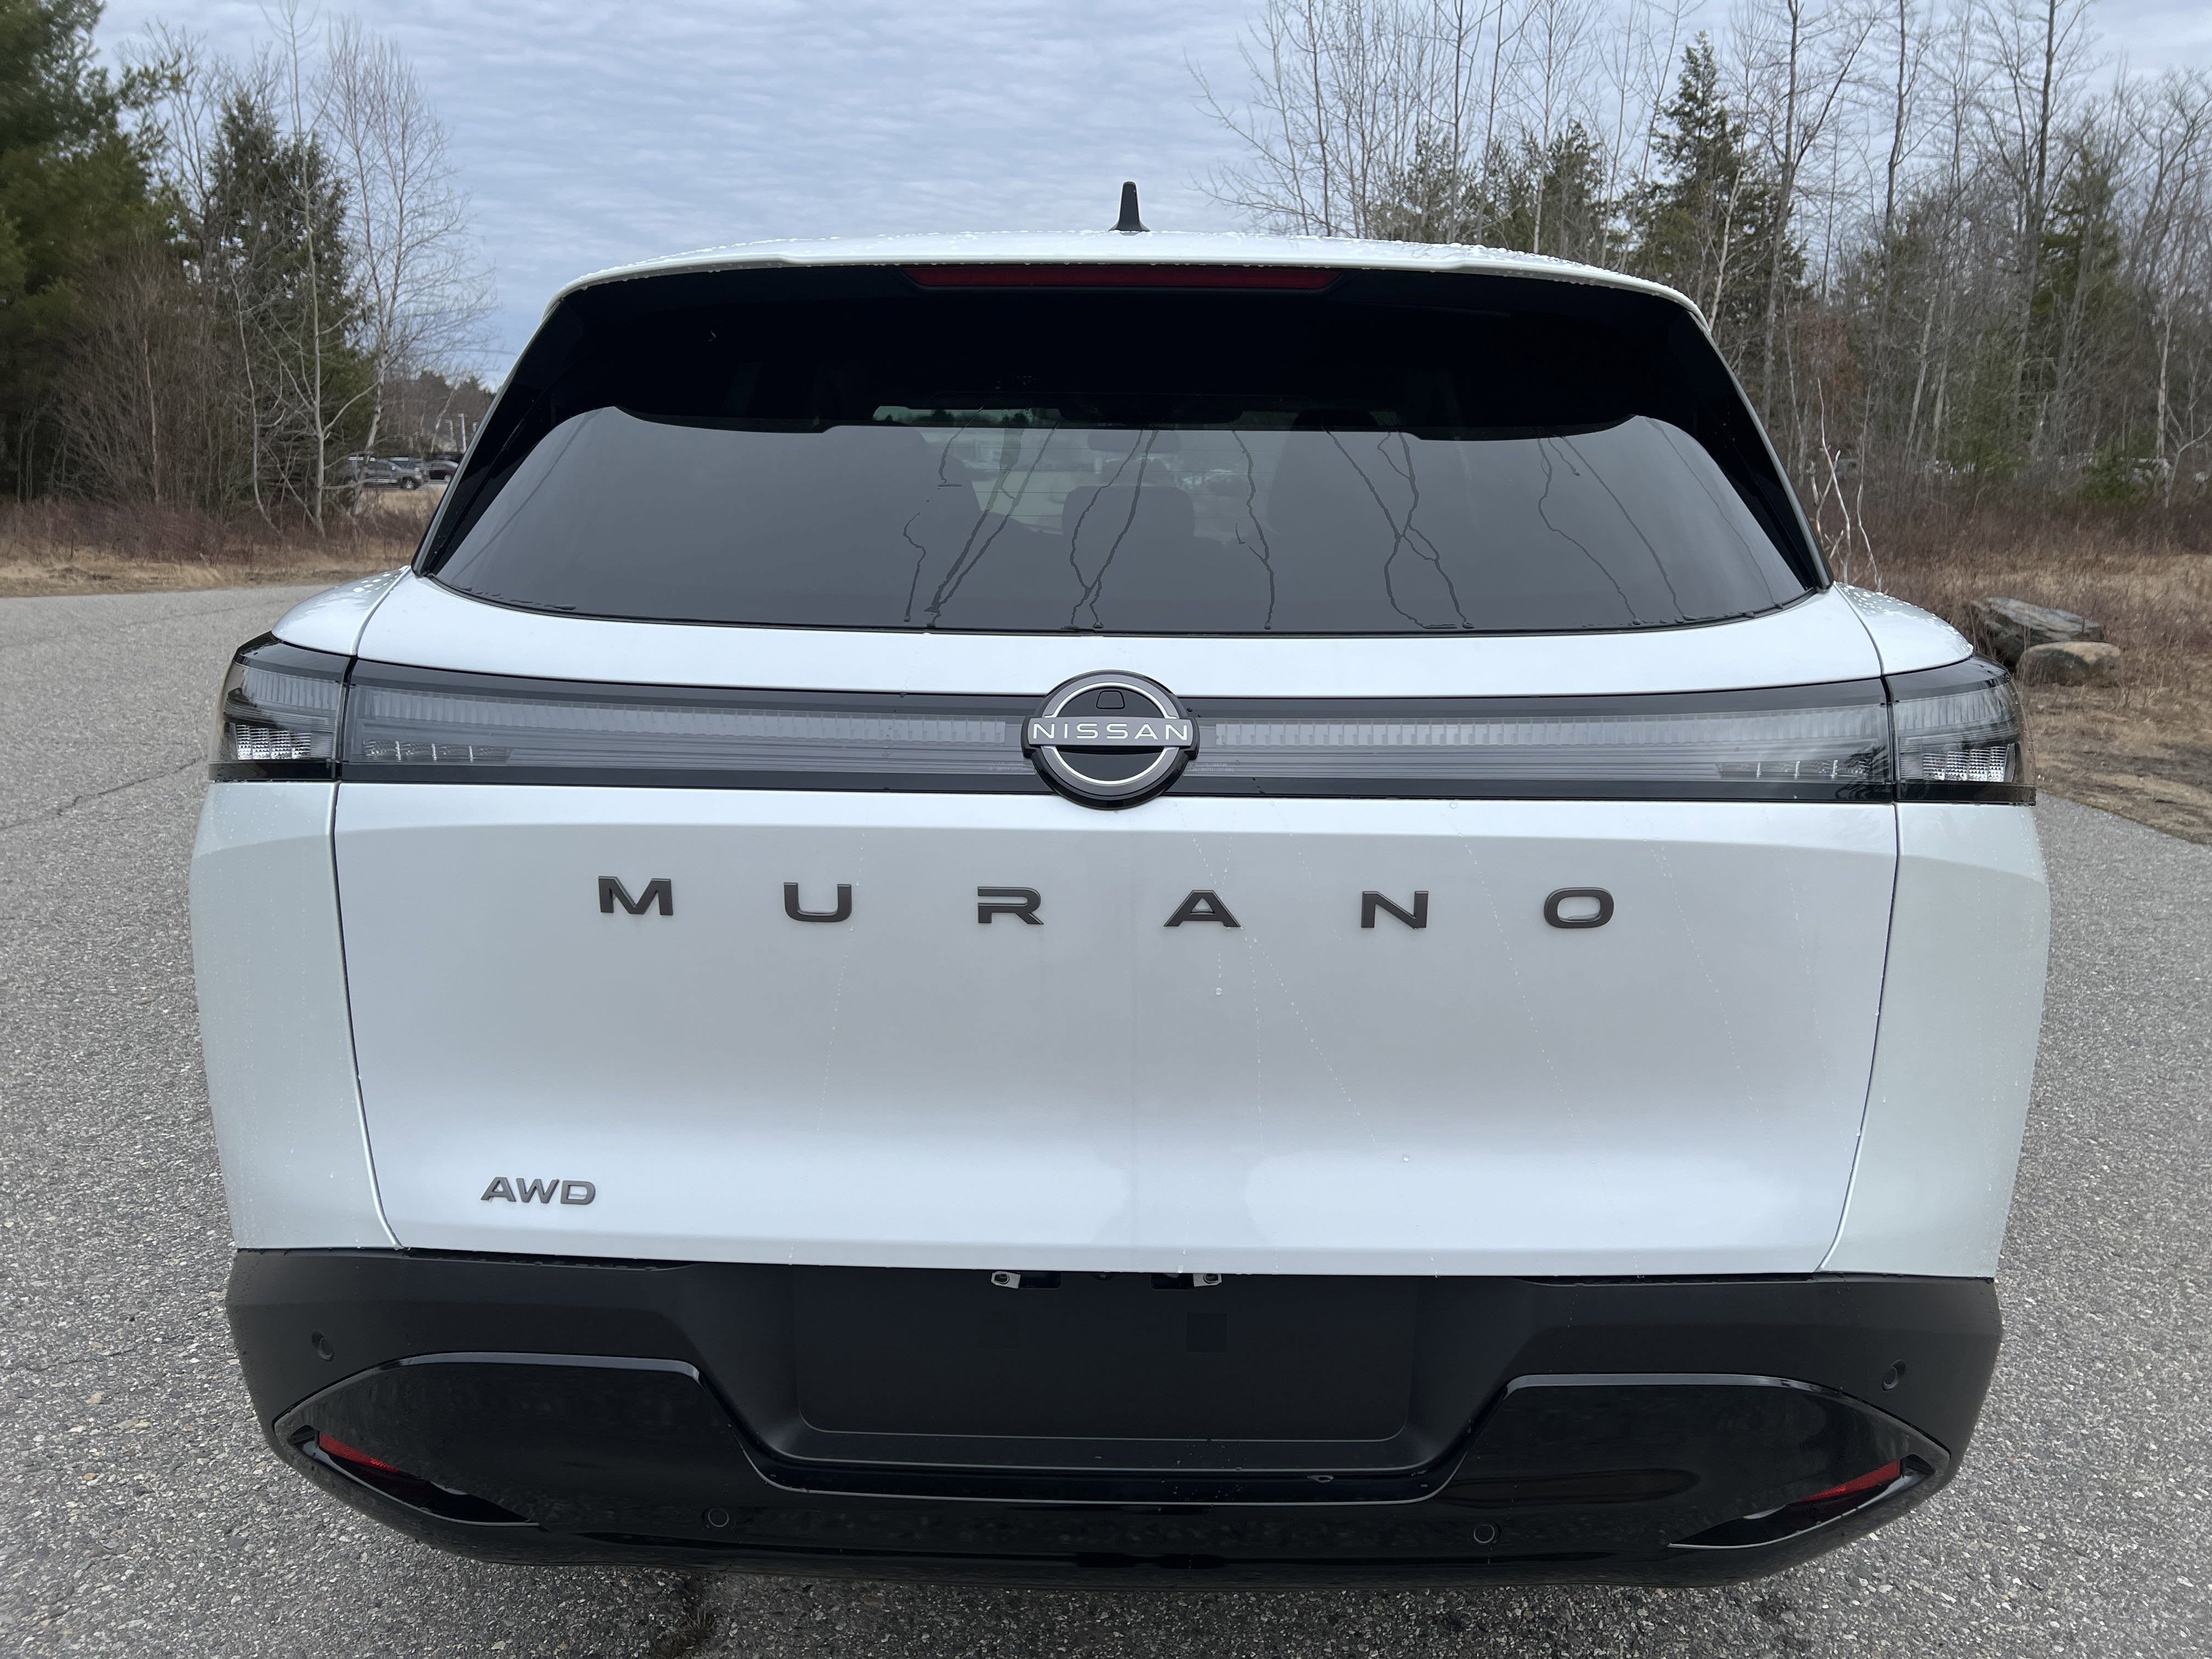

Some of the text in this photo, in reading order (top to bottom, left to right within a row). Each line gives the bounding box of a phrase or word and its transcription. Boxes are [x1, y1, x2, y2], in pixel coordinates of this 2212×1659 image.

[1033, 722, 1188, 741] NISSAN
[598, 876, 1615, 930] MURANO
[481, 1177, 596, 1205] AWD
